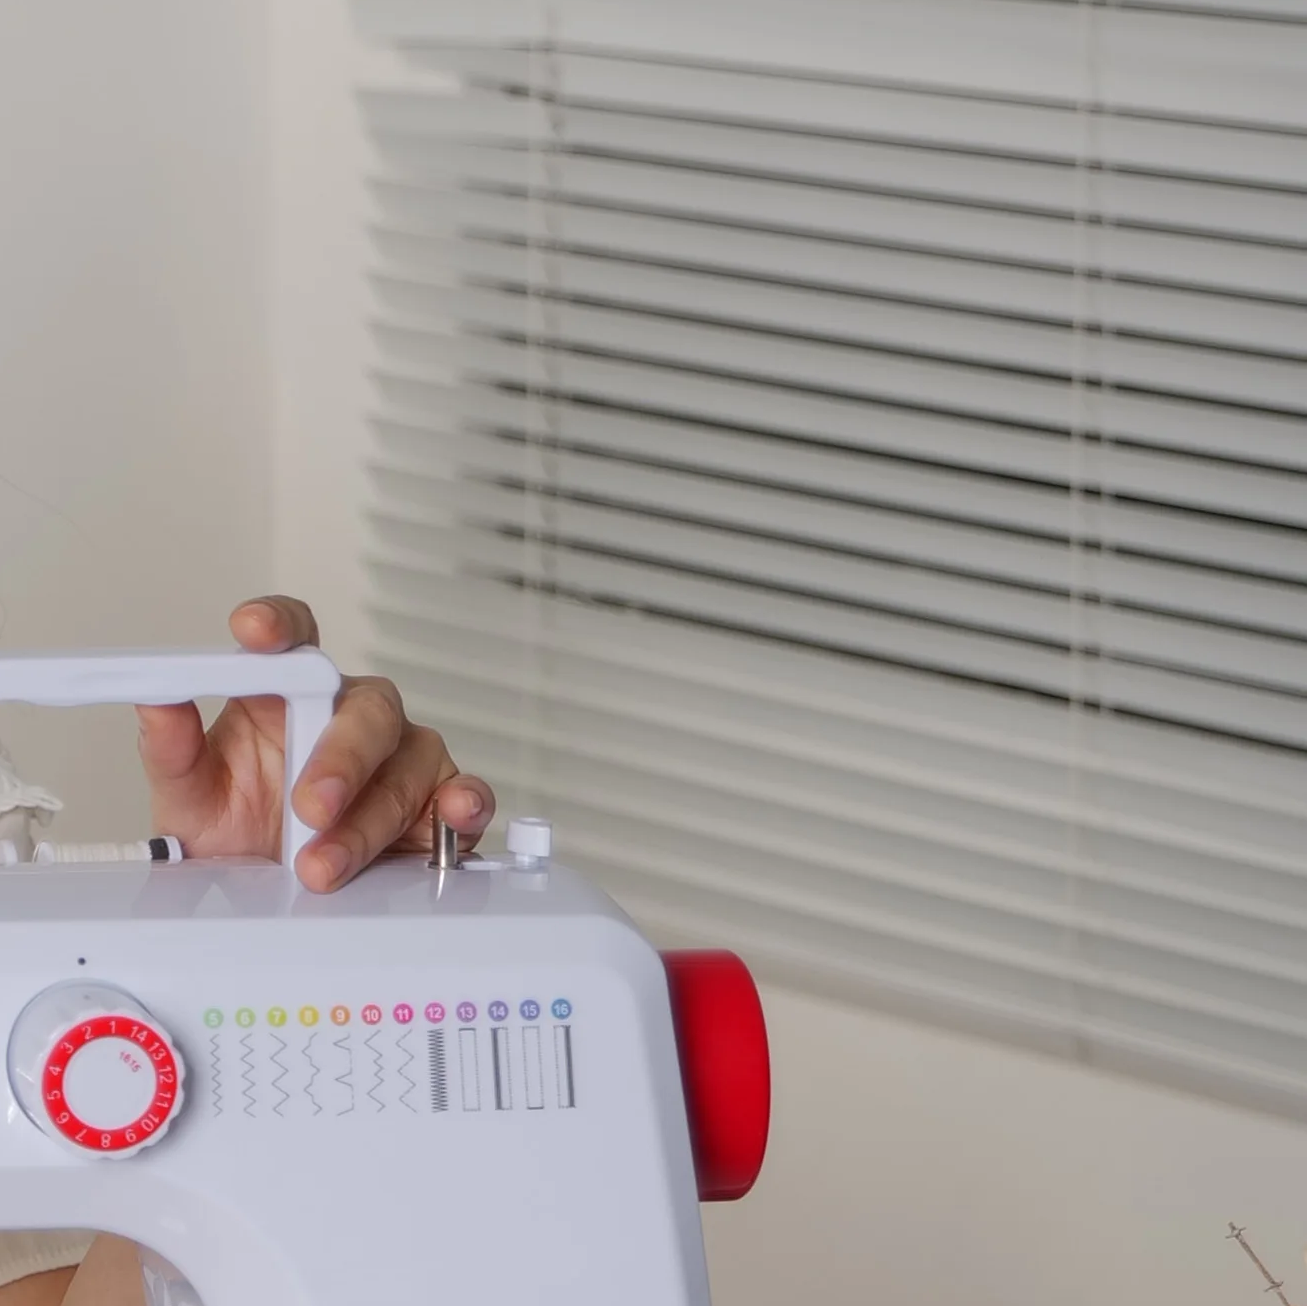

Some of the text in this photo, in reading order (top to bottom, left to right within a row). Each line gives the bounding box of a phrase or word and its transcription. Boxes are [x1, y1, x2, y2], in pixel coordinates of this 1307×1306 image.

[46, 1020, 175, 1148] 1 2 3 4 5 6 7 8 9 10 11 12 13 14
